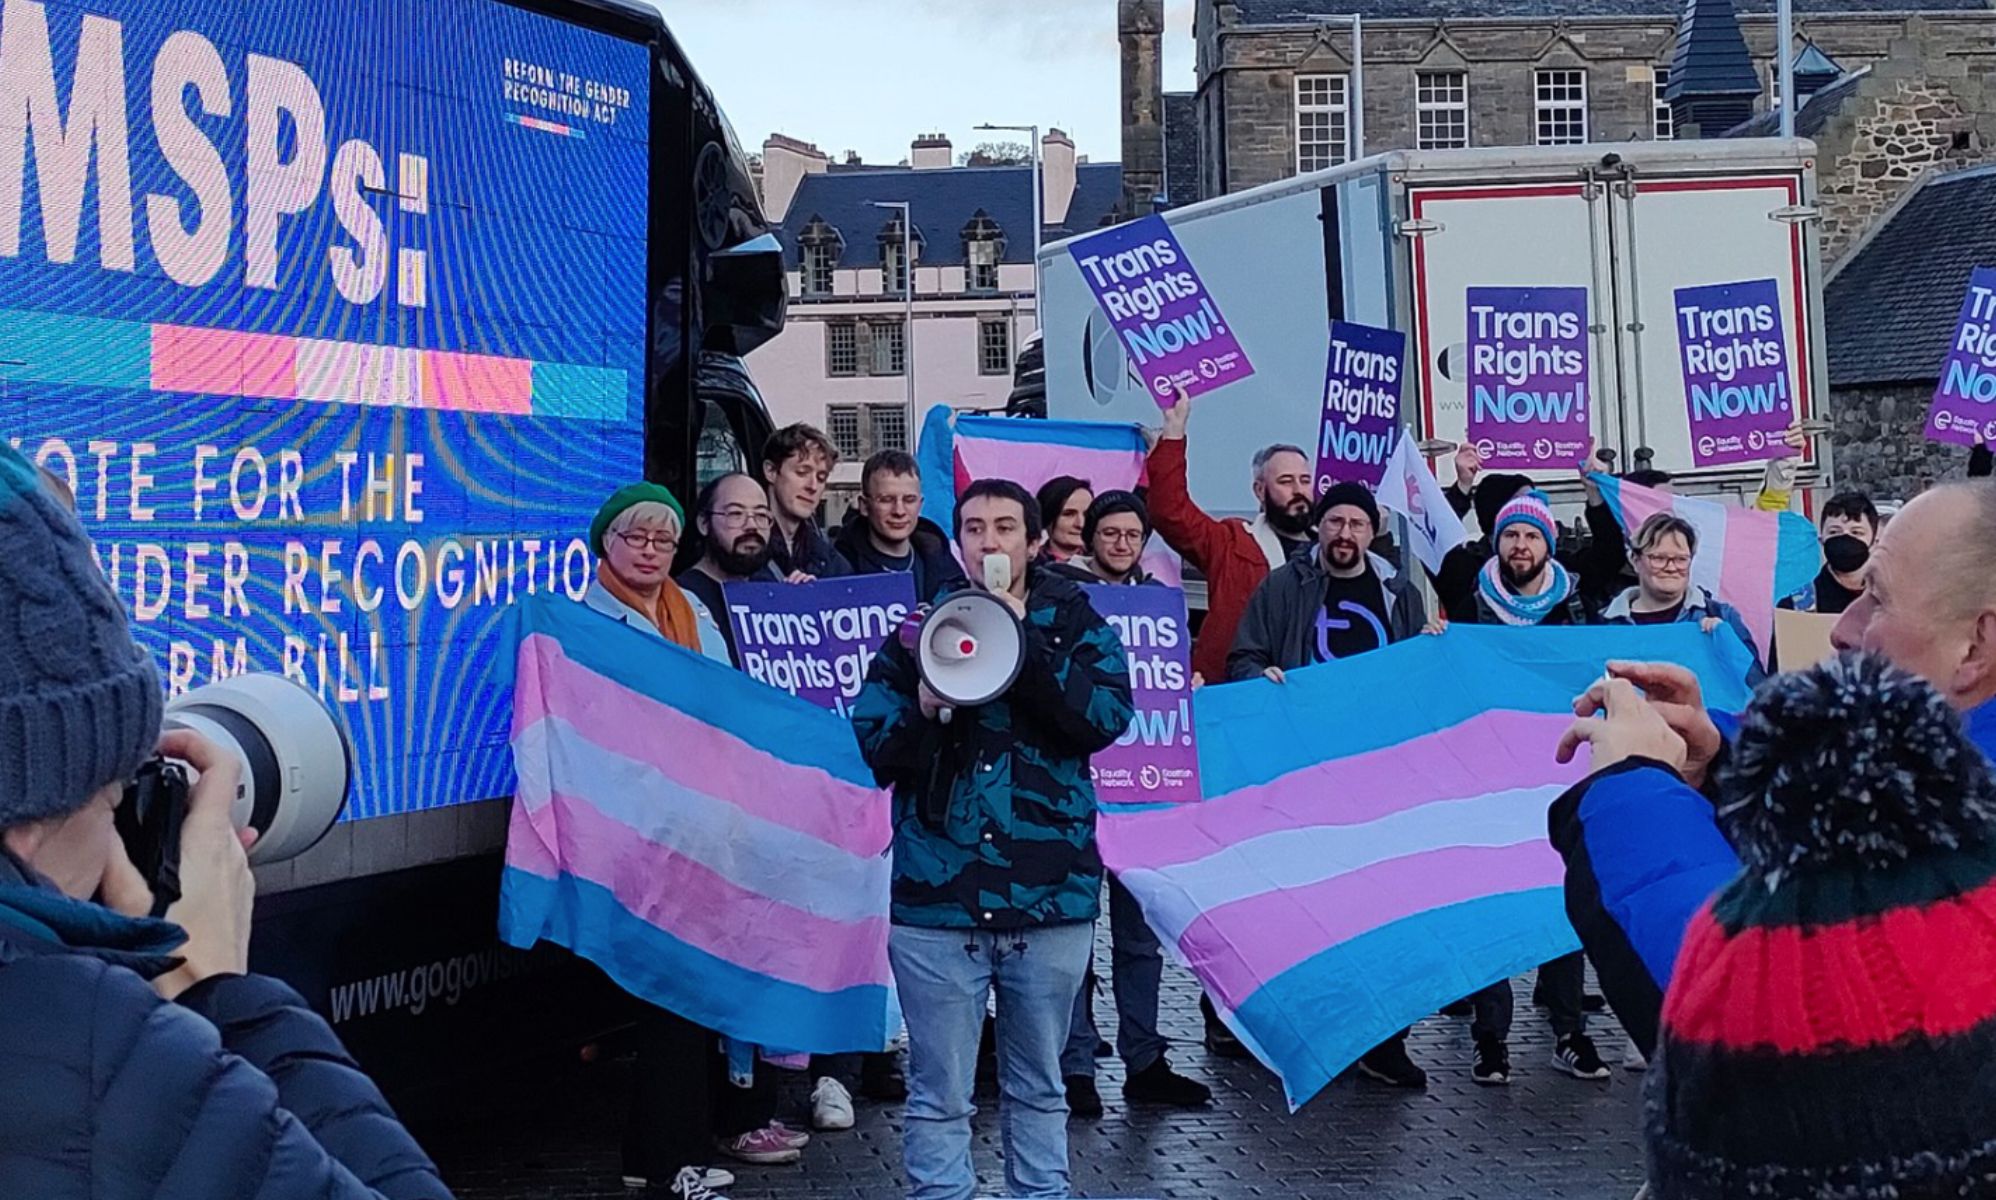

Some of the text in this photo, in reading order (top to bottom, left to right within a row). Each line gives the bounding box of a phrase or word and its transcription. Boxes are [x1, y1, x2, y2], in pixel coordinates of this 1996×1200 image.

[504, 57, 630, 108] REFORM THE GENDER
[504, 80, 616, 126] RECOGNITION ACT
[1080, 239, 1177, 288] Trans
[1102, 271, 1198, 321] Rights
[1123, 298, 1226, 365] Now!
[1471, 306, 1579, 339] Trans
[1679, 304, 1774, 339] Trans
[1332, 340, 1397, 383] Trans
[1474, 341, 1583, 386] Rights
[1685, 337, 1781, 382] Rights
[1942, 359, 1996, 403] No
[1327, 378, 1396, 424] Rights
[1474, 381, 1585, 424] Now!
[1691, 371, 1789, 421] Now!
[1320, 420, 1394, 466] Now!
[11, 437, 425, 523] OTE FOR THE
[283, 538, 590, 614] RECOGNITIO
[730, 604, 821, 646] Trans
[819, 603, 908, 641] rans
[1105, 614, 1178, 648] ans
[745, 648, 835, 697] Rights
[1127, 652, 1185, 690] hts
